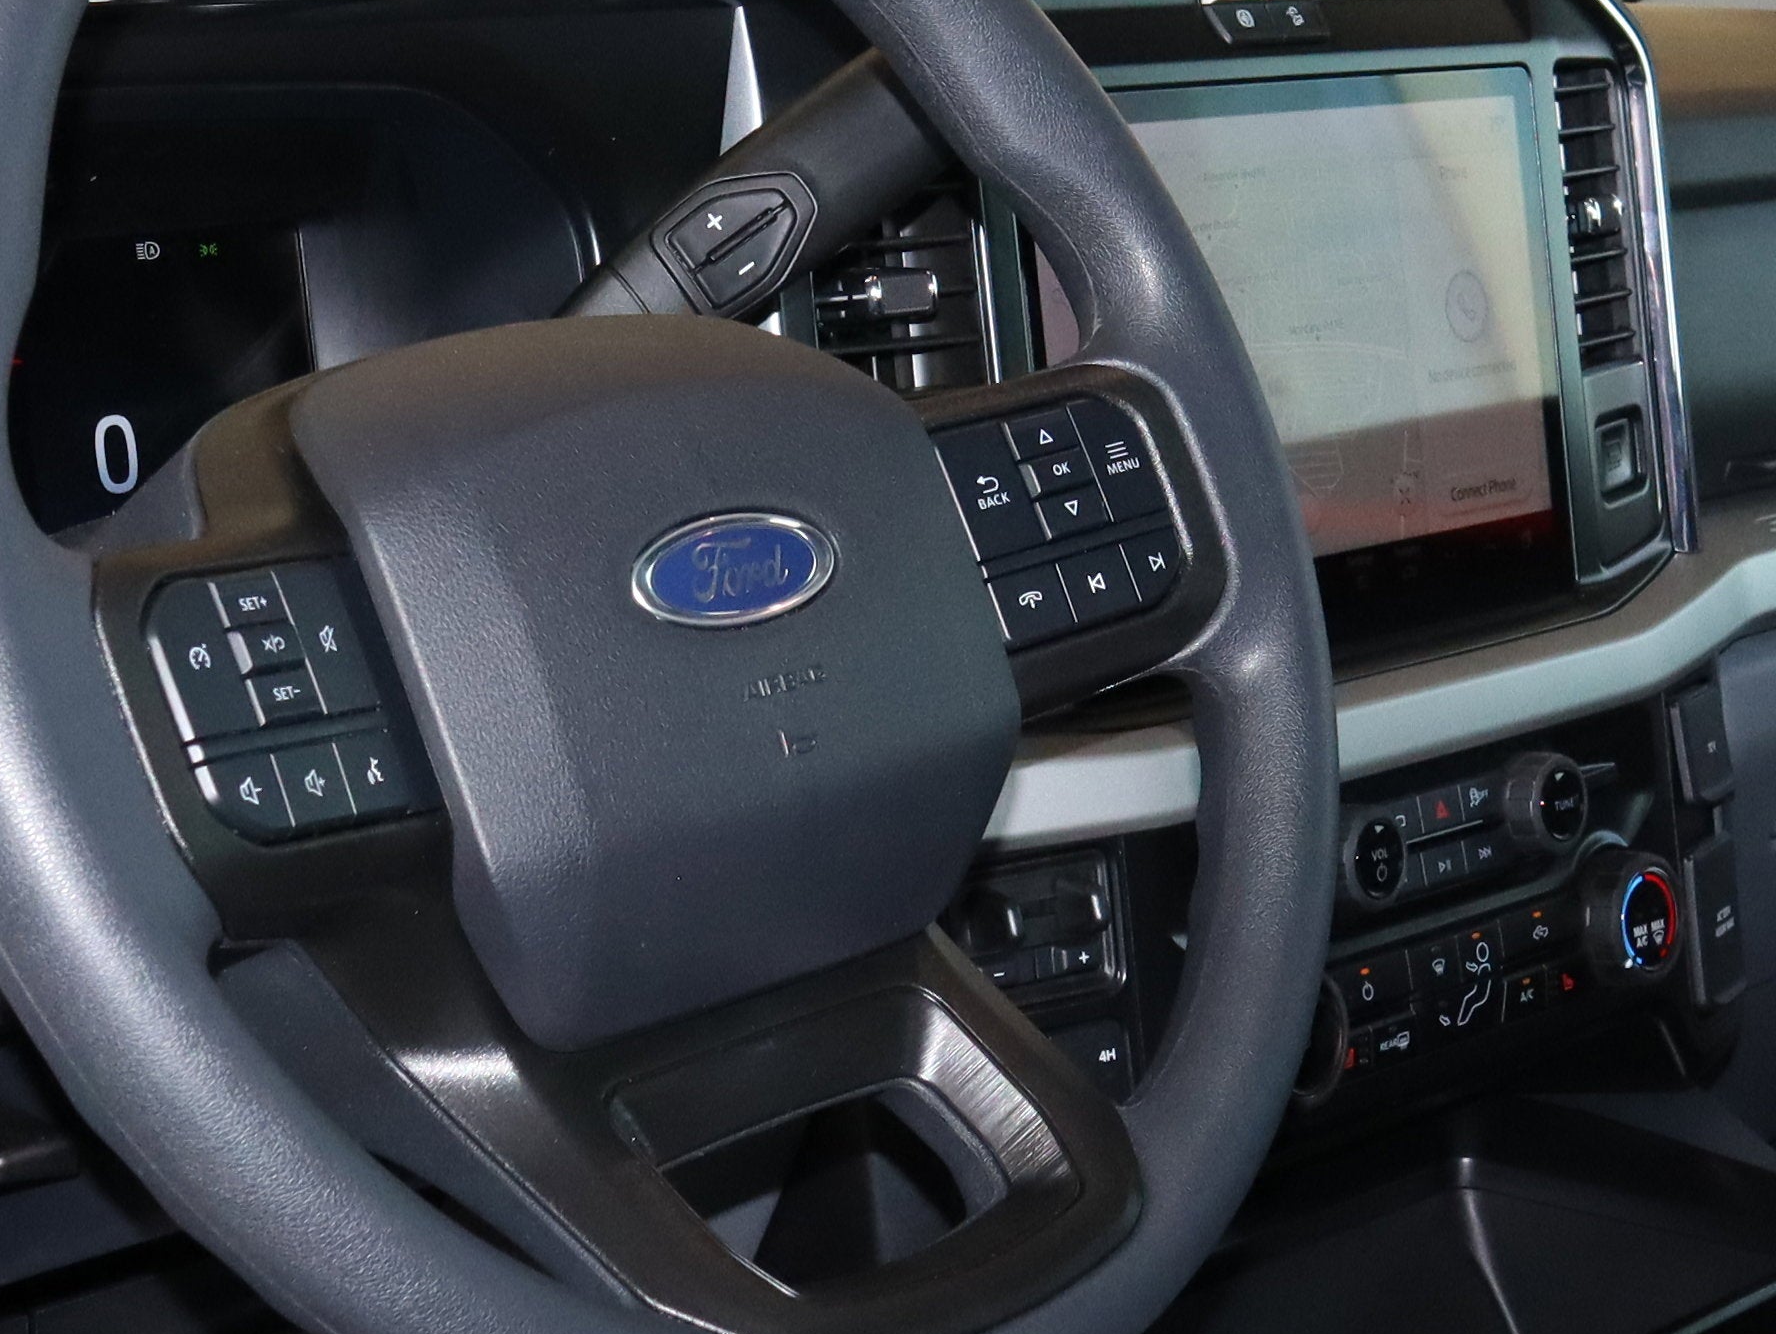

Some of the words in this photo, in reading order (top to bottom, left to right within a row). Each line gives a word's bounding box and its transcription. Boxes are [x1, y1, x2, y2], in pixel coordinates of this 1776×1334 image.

[93, 413, 139, 495] 0
[1051, 460, 1072, 477] OK
[1106, 456, 1142, 476] MENU
[977, 490, 1010, 511] BACK
[1450, 482, 1489, 504] Connect
[1488, 476, 1519, 497] Phone
[691, 537, 791, 604] Ford
[1098, 1047, 1117, 1063] 4H
